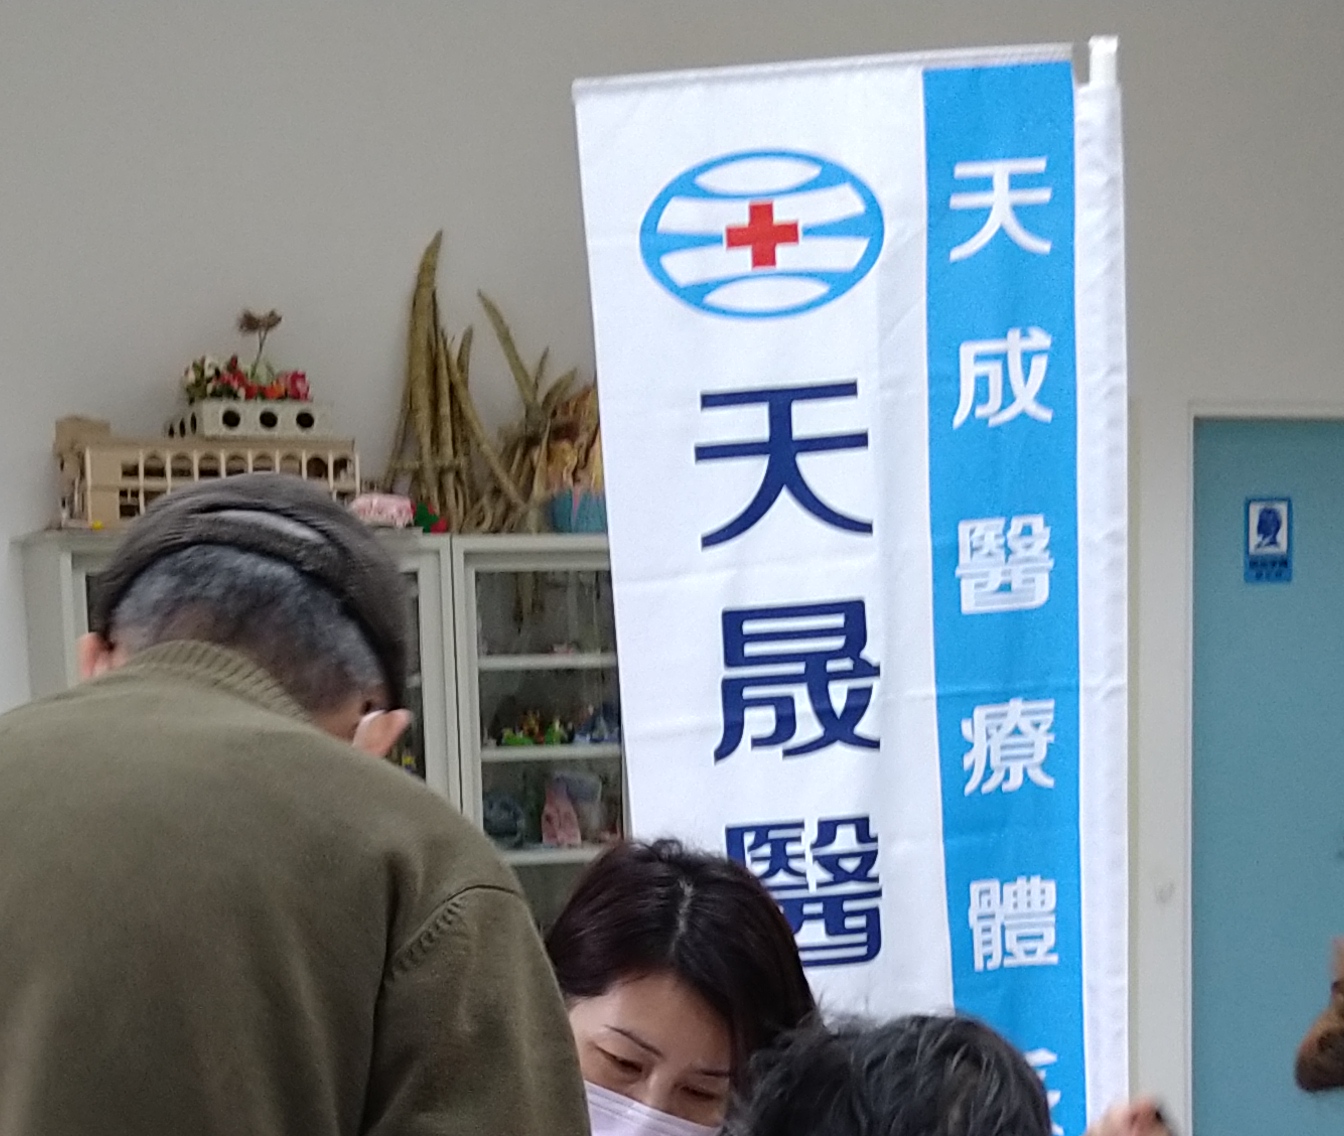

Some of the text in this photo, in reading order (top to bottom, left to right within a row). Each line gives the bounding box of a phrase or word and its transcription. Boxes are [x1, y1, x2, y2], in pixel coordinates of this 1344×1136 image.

[694, 379, 883, 968] 天晟醫
[948, 154, 1064, 1136] 天成醫療體
